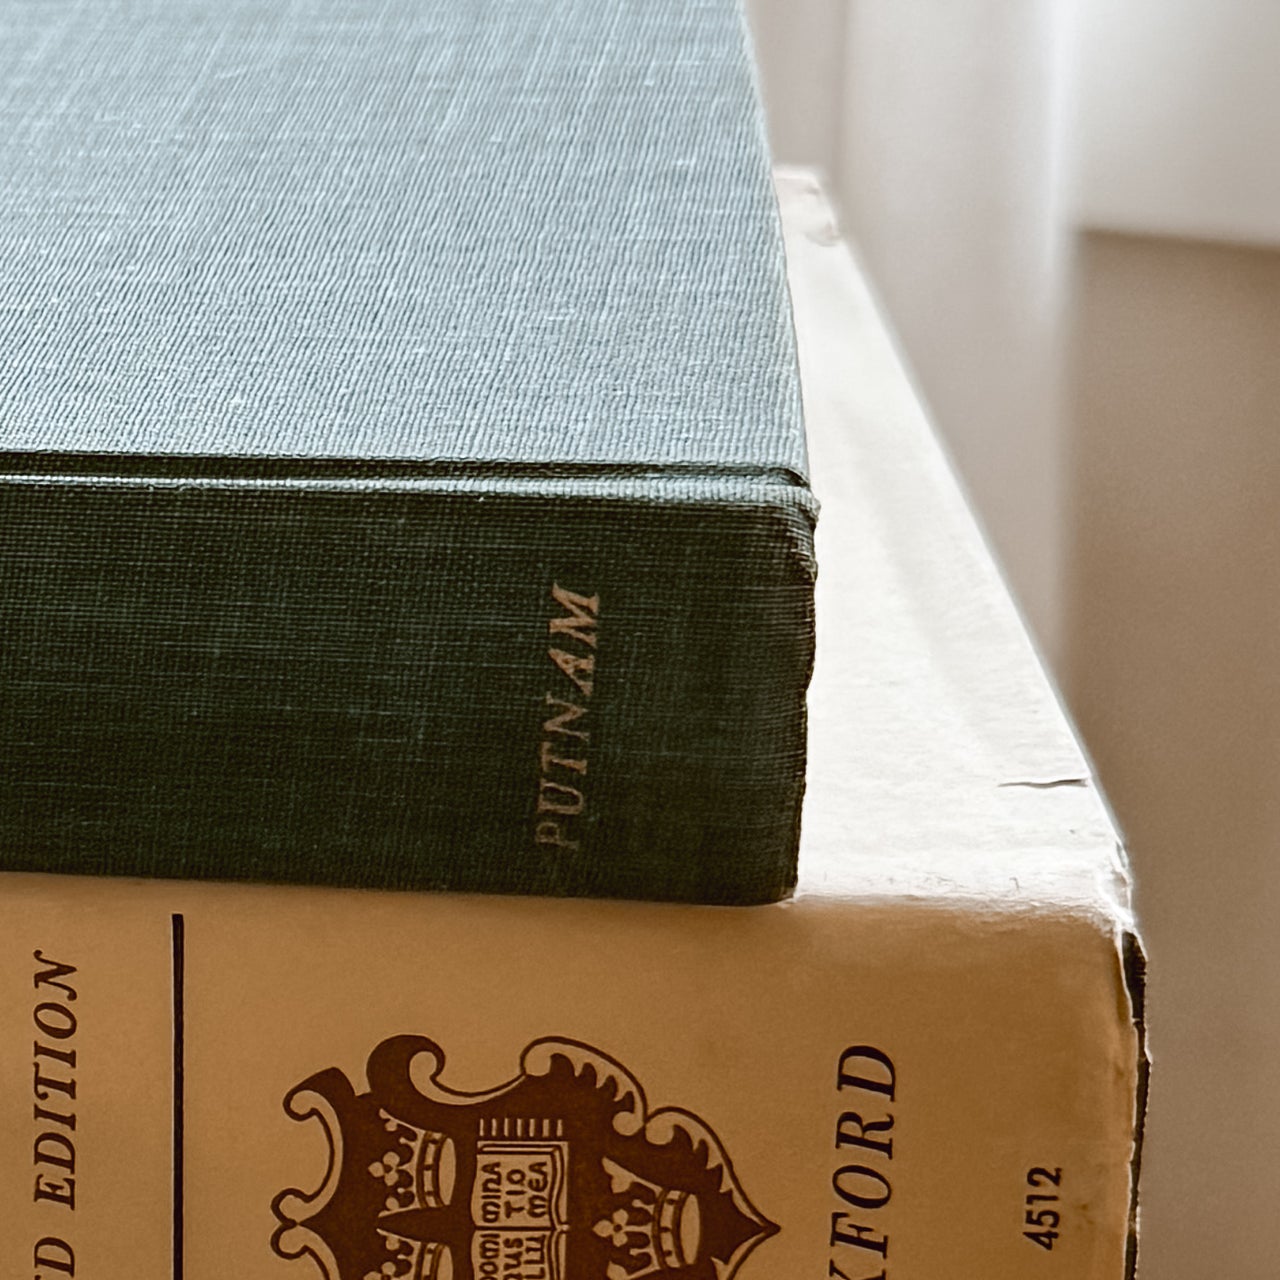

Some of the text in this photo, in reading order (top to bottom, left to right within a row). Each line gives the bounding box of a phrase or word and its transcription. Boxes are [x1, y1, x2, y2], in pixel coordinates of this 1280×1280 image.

[536, 582, 599, 850] PUTNAM
[34, 949, 80, 1210] EDITION
[1022, 1167, 1064, 1251] 4512
